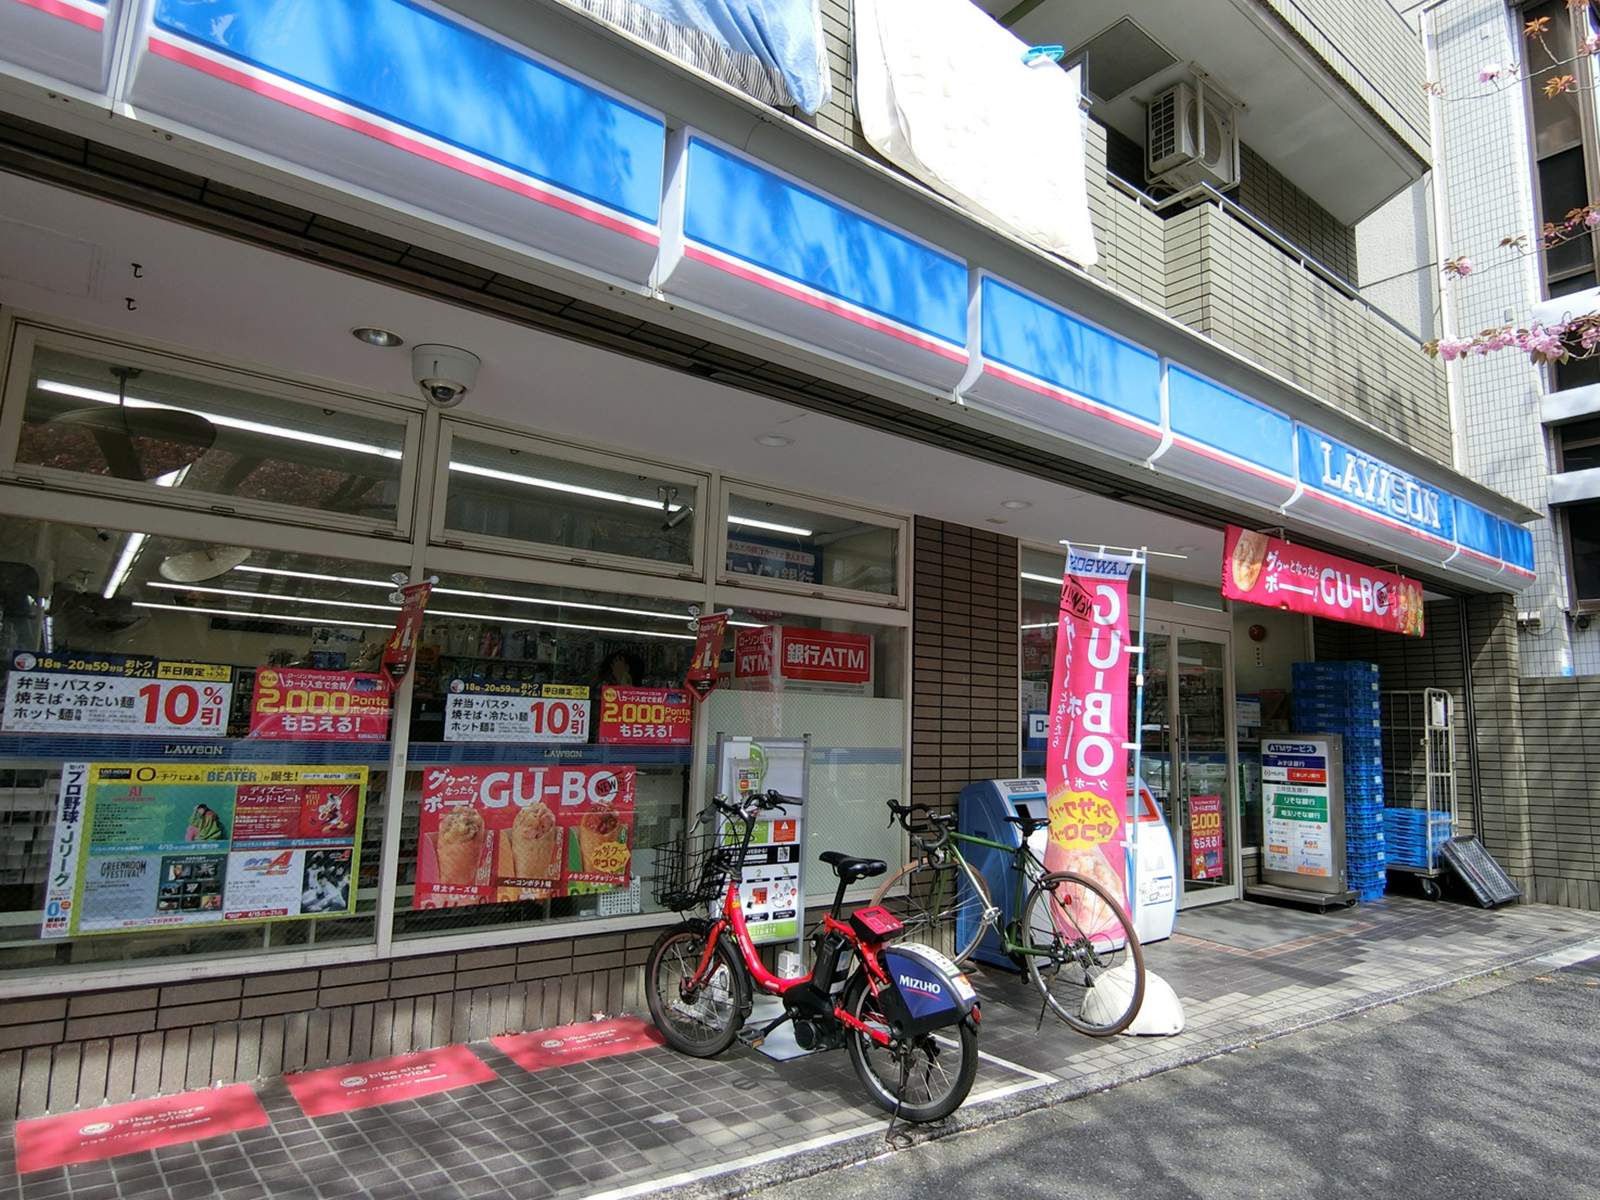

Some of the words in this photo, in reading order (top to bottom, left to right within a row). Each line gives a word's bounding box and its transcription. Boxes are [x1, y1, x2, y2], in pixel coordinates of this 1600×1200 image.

[1320, 441, 1442, 530] LAWSON
[1320, 568, 1389, 616] GU-BO
[787, 643, 864, 669] 銀行ATM
[125, 660, 153, 669] おトク
[740, 654, 770, 672] ATM
[124, 668, 156, 678] タイム!
[161, 665, 205, 677] 平日限定
[17, 676, 114, 692] 弁当・パスタ・
[544, 687, 573, 696] 平日限定
[15, 691, 135, 709] 焼そば・冷たい麺
[257, 688, 350, 716] 2,000
[350, 695, 388, 706] Ponta
[453, 698, 514, 709] 弁当・パスタ・
[349, 706, 388, 716] ポイント
[451, 710, 528, 722] 焼そば・冷たい麺
[603, 703, 665, 724] 2,000
[665, 707, 690, 715] Ponta
[281, 715, 361, 733] もらえる!
[665, 715, 690, 724] ポイント
[620, 724, 673, 738] もらえる!
[164, 745, 223, 755] LAWSON
[544, 750, 582, 758] LAWSON
[1270, 744, 1314, 753] ATMサービス
[445, 786, 475, 796] なったら
[480, 771, 619, 808] GU-BO
[623, 771, 634, 803] グーボ
[239, 794, 302, 804] ワールド・ビート
[1284, 797, 1315, 806] りそな銀行
[1281, 809, 1320, 819] 埼玉りそな銀行
[1192, 813, 1220, 830] 2,000
[1193, 836, 1220, 849] もらえる!
[101, 860, 147, 876] GREENROOM
[106, 869, 140, 879] FESTIVAL
[756, 868, 762, 877] 2
[503, 878, 552, 889] ベーコンポテト味
[567, 873, 625, 882] メキシカンチョリソー味
[432, 884, 479, 894] 明太チーズ味
[899, 974, 941, 994] MIZUHO
[369, 1069, 397, 1079] bike
[400, 1063, 437, 1074] share
[382, 1068, 431, 1081] service
[118, 1115, 154, 1125] bike
[158, 1105, 205, 1117] share
[132, 1112, 195, 1128] service
